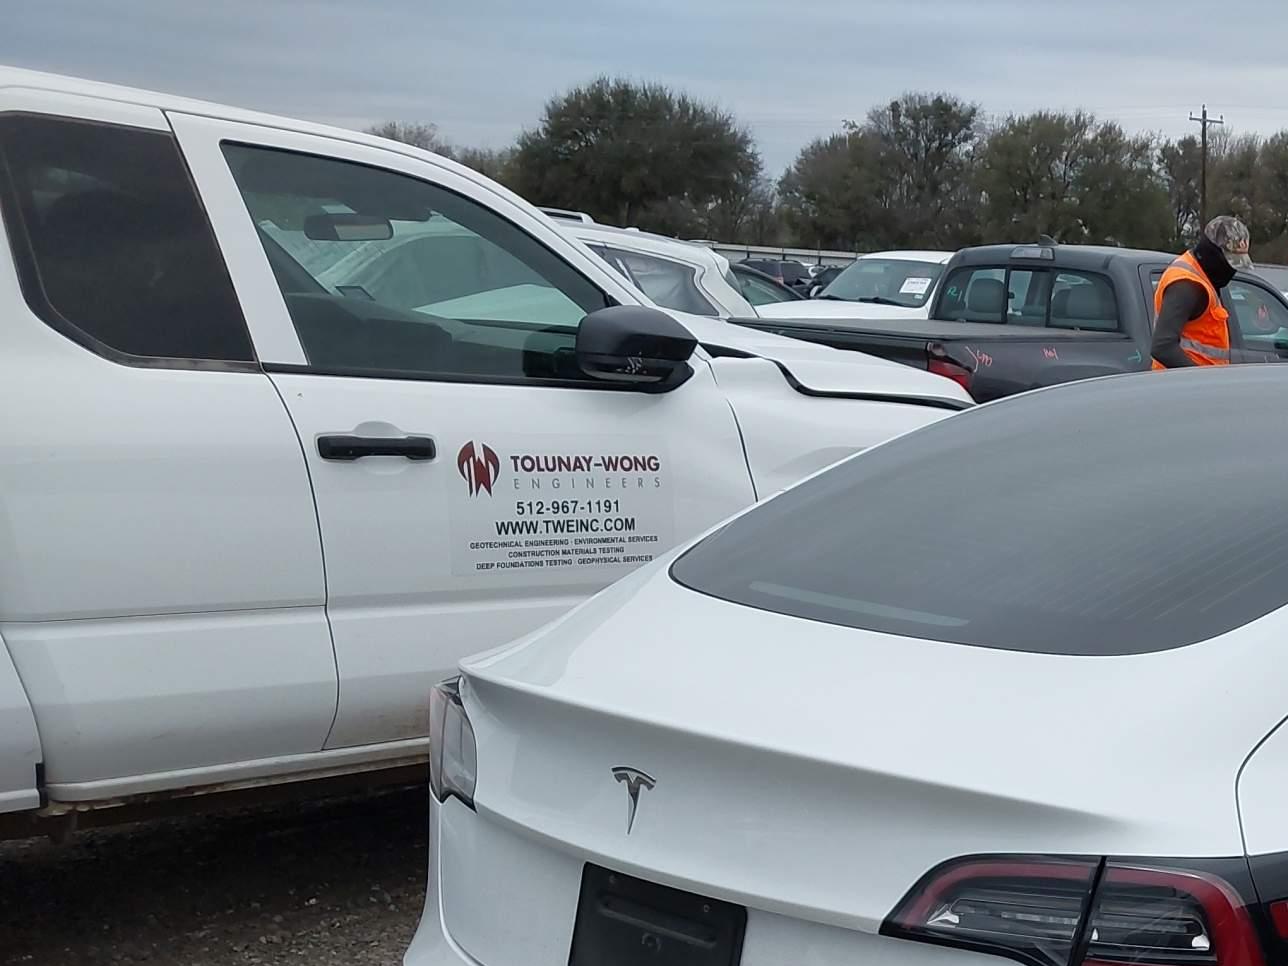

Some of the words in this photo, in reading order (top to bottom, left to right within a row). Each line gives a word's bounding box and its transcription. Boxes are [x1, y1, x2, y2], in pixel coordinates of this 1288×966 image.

[510, 455, 660, 473] TOLUNAY-WONG
[514, 477, 661, 489] ENGINEERS
[516, 499, 620, 515] 512-967-1191
[495, 518, 636, 535] WWW.TWEINC.COM
[469, 541, 522, 549] GEOTECHNICAL
[524, 538, 569, 547] ENGINEERING
[574, 536, 626, 545] ENVIRONMENTAL
[627, 535, 658, 543] SERVICES
[508, 548, 560, 558] CONSTRUCTION
[561, 547, 597, 556] MATERIALS
[598, 546, 625, 554] TESTING
[476, 562, 495, 570] DEEP
[496, 560, 544, 569] FOUNDATIONS
[545, 558, 573, 567] TESTING
[577, 556, 621, 565] GEOPHYSICAL
[622, 555, 653, 563] SERVICES
